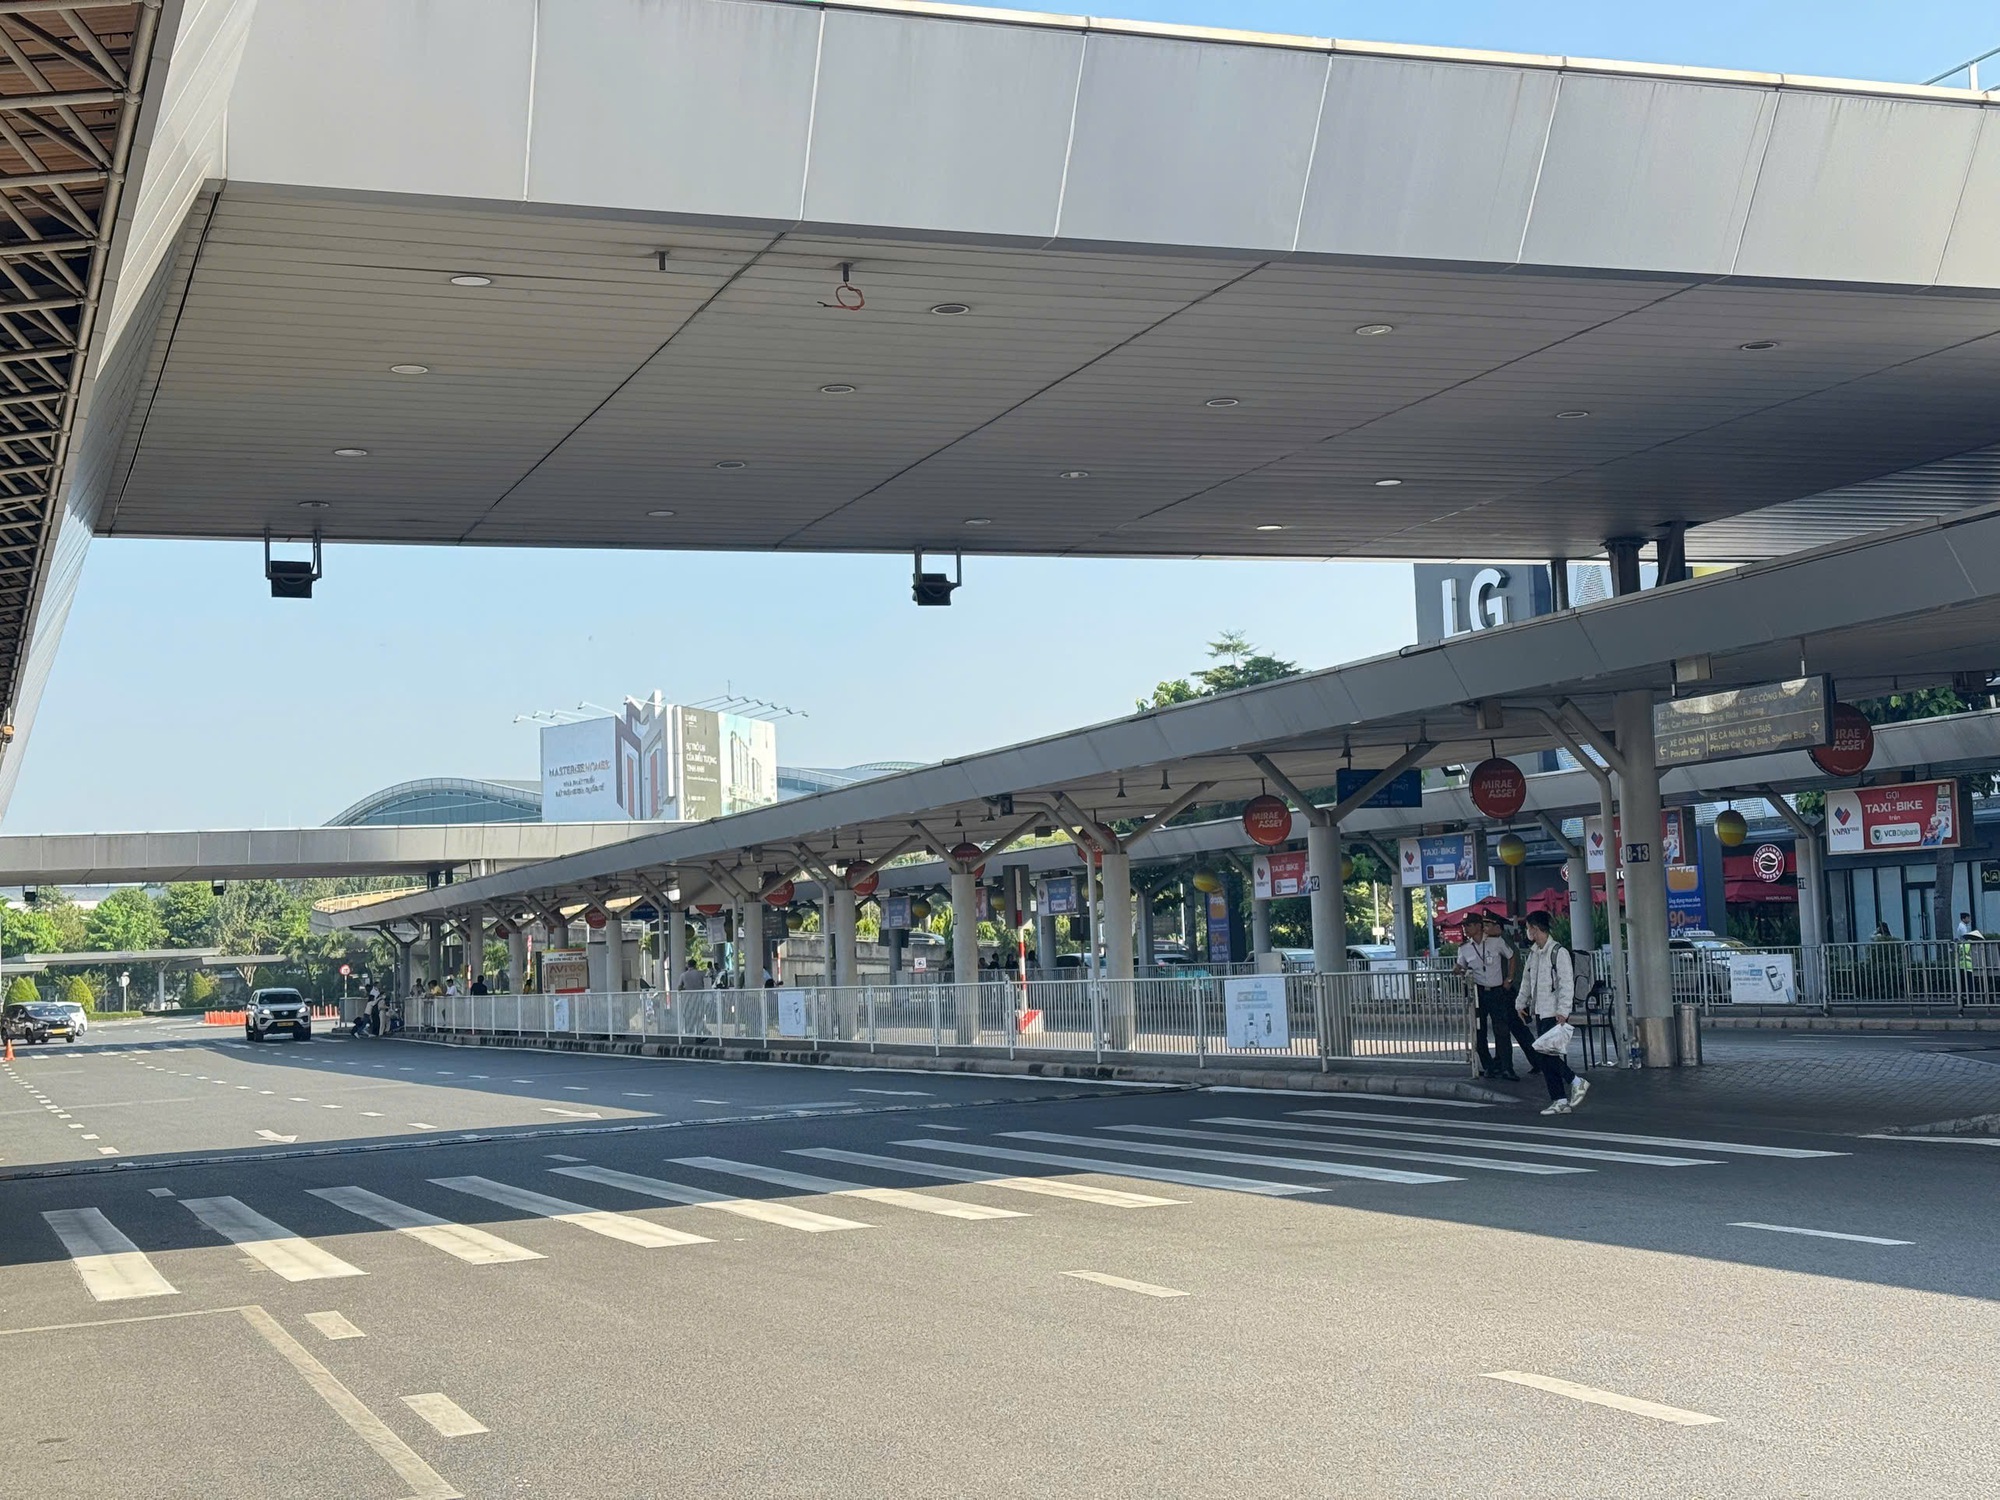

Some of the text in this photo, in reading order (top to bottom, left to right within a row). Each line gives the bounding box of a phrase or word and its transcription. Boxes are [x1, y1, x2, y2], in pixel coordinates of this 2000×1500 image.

[1442, 568, 1511, 638] LG
[1758, 723, 1772, 733] BUS
[1836, 729, 1861, 739] IRAE
[1709, 742, 1730, 752] Private
[1743, 738, 1756, 748] City
[1793, 730, 1806, 740] Bus
[1832, 740, 1866, 751] ASSET
[1670, 746, 1700, 758] Private Car
[1481, 779, 1513, 790] MIRAE
[1488, 789, 1517, 798] ASSET
[1252, 811, 1279, 821] MIRAE
[1258, 820, 1284, 828] ASSET
[1669, 910, 1685, 927] 90
